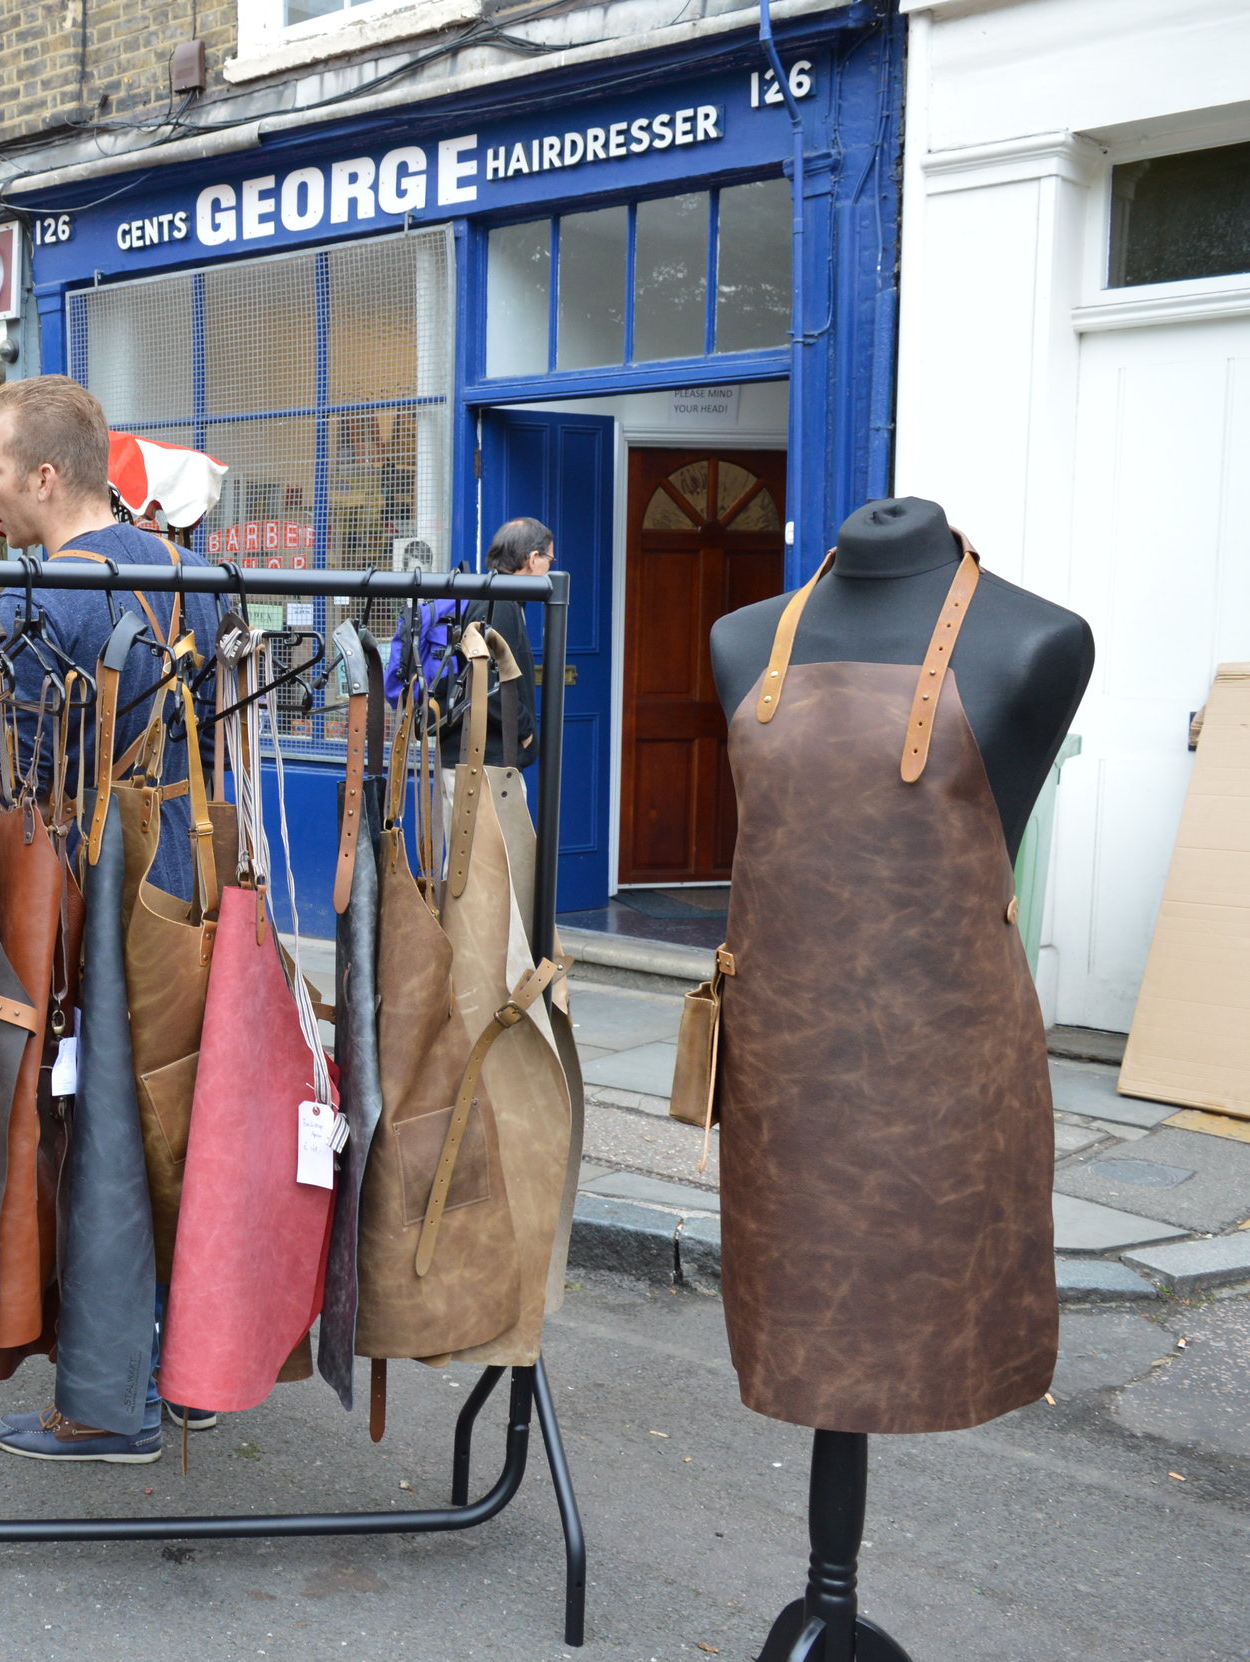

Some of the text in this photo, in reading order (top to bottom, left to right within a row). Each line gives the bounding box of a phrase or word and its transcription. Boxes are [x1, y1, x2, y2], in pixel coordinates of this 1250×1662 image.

[751, 60, 812, 108] 126
[117, 104, 719, 250] GENTS GEORGE HAIRDRESSER
[35, 214, 71, 246] 126
[673, 404, 727, 413] YOUR HEAD!
[674, 389, 733, 398] PLEASE MIND
[209, 522, 314, 552] BARBER
